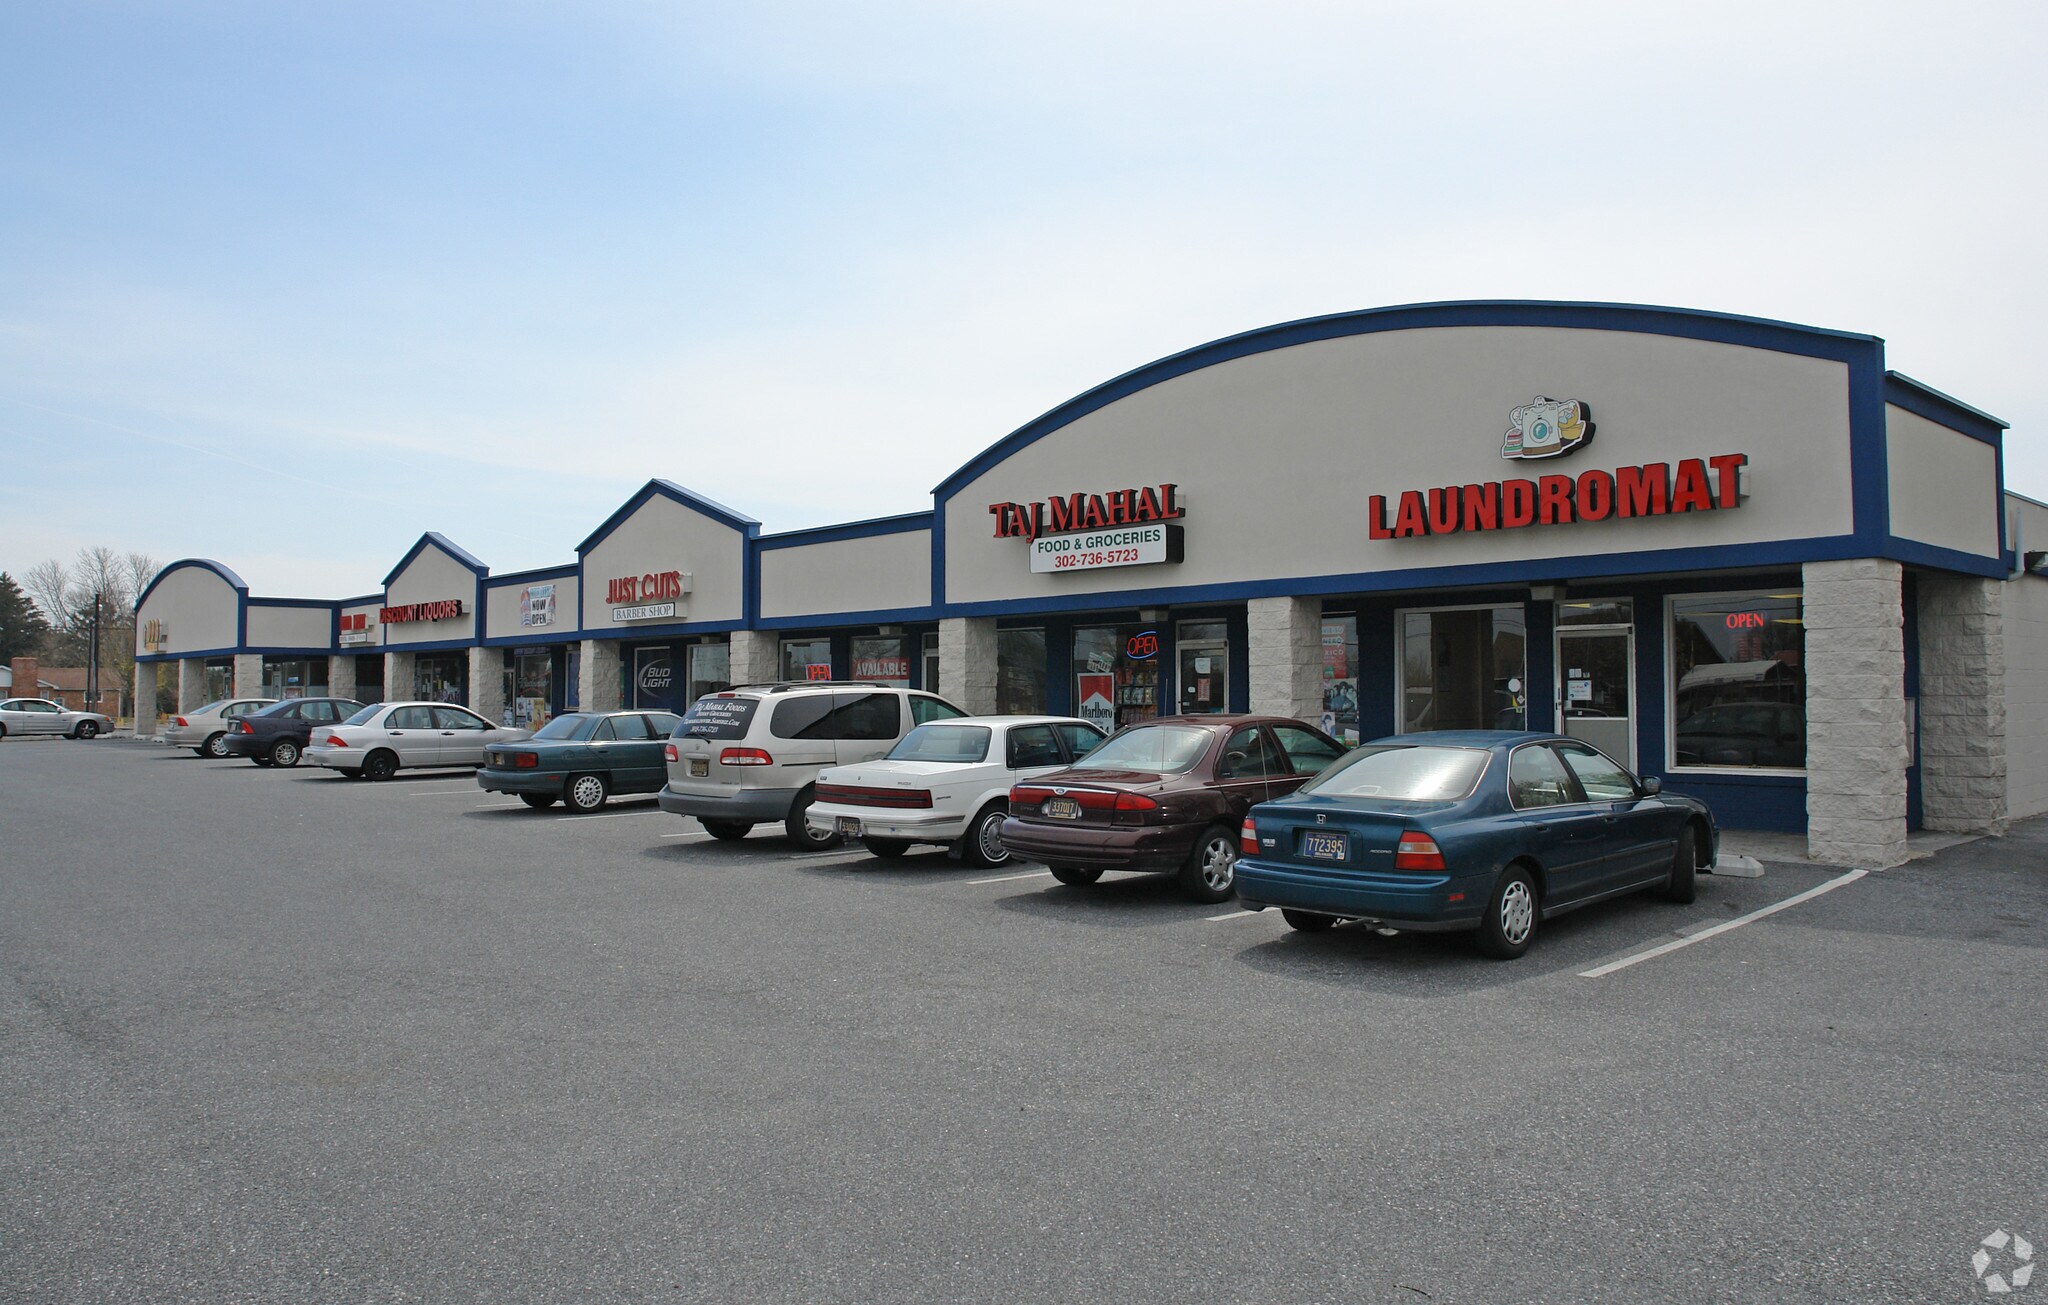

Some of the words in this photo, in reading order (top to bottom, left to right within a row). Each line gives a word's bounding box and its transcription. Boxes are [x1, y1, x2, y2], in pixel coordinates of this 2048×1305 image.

[1369, 453, 1748, 540] LAUNDROMAT
[989, 502, 1043, 543] TAJ
[1048, 484, 1184, 532] MAHAL
[1038, 539, 1070, 553] FOOD
[1074, 538, 1083, 550] &
[1086, 529, 1161, 549] GROCERIES
[1055, 548, 1138, 568] 302-736-5723
[606, 576, 637, 604] JUST
[641, 571, 681, 600] CUTS
[380, 604, 418, 624] DISCOUNT
[419, 599, 459, 622] LIQUORS
[531, 599, 547, 611] NOW
[616, 607, 647, 620] BARBER
[649, 605, 672, 617] SHOP
[531, 612, 547, 625] OPEN
[1726, 612, 1764, 629] OPEN
[1127, 636, 1159, 655] OPEN
[647, 667, 671, 678] BUD
[808, 665, 832, 681] OPEN
[856, 662, 907, 676] AVAILABLE
[642, 678, 671, 688] LIGHT
[1081, 701, 1113, 718] Marlboro
[1051, 800, 1075, 814] 337017
[1307, 837, 1345, 854] 772395
